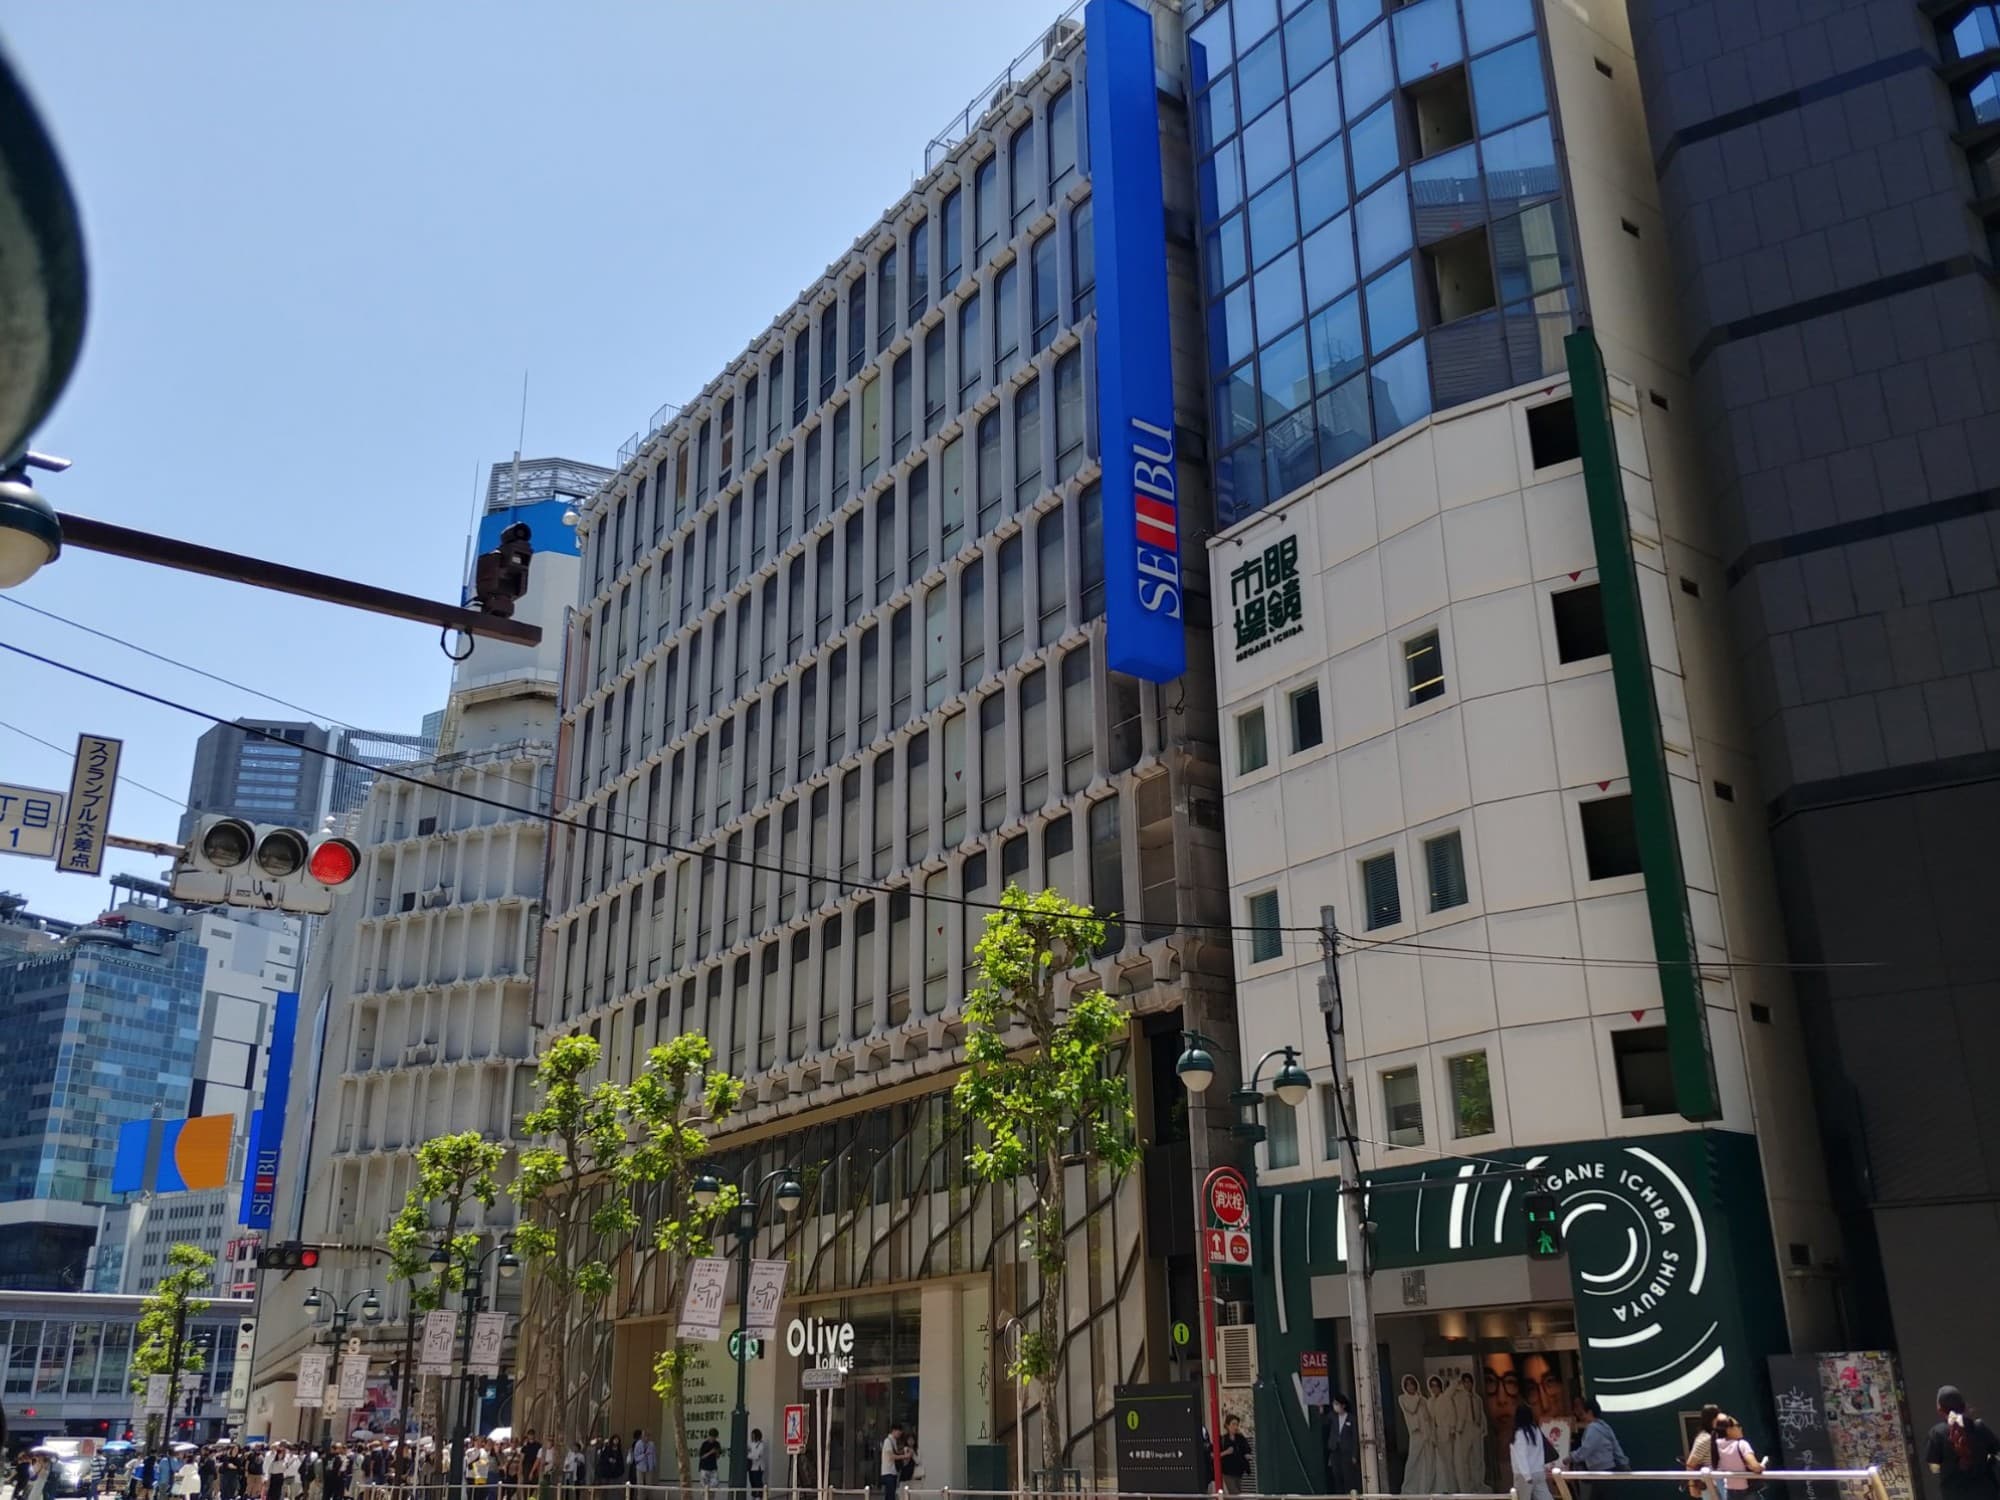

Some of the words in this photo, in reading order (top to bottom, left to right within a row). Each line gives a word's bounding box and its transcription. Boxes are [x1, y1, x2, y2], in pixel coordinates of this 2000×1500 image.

[1131, 417, 1181, 620] SEIBU
[1236, 639, 1271, 663] MEGANE
[1273, 623, 1304, 645] ICHIBA
[69, 741, 110, 869] スクランブル交差点
[9, 827, 21, 848] 1
[252, 1150, 277, 1216] SEIBU
[1543, 1163, 1605, 1193] GANE
[1215, 1190, 1243, 1210] 消火栓
[1619, 1169, 1676, 1235] ICHIBA
[1612, 1250, 1679, 1322] SHIBUYA
[787, 1316, 855, 1357] Olive
[1302, 1353, 1328, 1368] SALE
